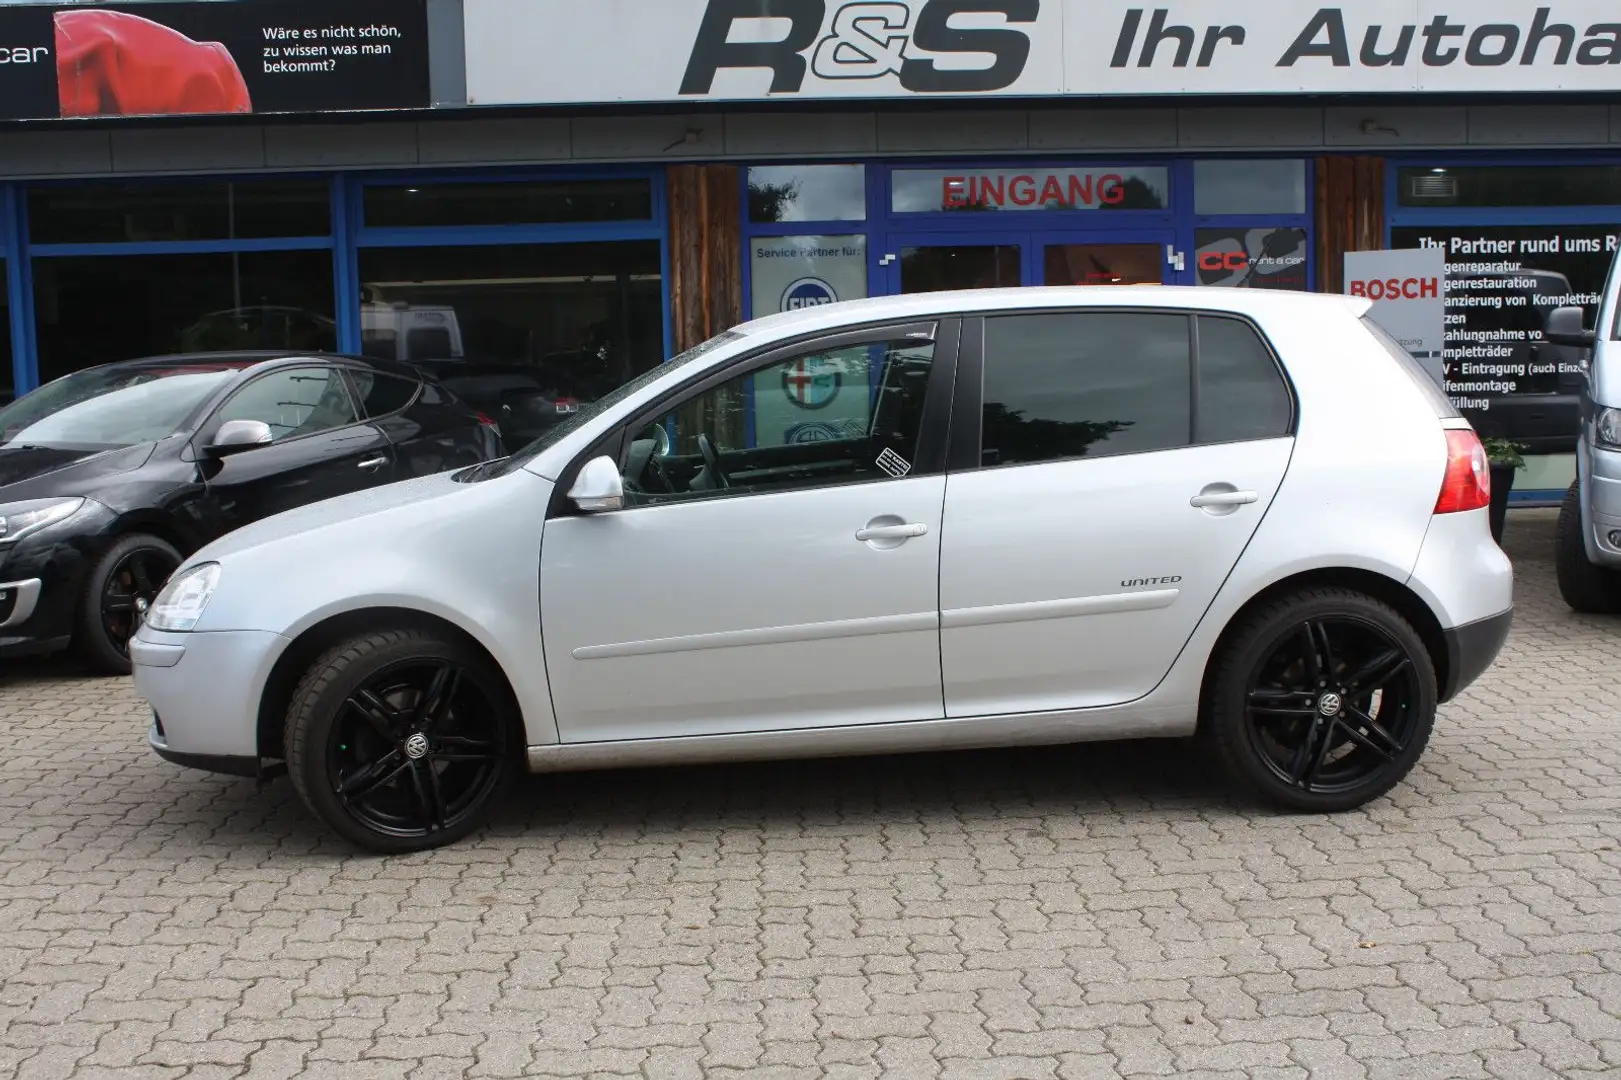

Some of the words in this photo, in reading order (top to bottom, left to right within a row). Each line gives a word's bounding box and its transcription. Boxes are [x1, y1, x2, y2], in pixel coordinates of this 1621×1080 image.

[263, 27, 299, 40] Wäre
[303, 28, 318, 39] es
[321, 25, 355, 38] nicht
[358, 24, 402, 38] schön,
[1110, 8, 1246, 68] Ihr
[263, 46, 280, 57] zu
[284, 44, 328, 56] wissen
[331, 45, 358, 55] was
[361, 44, 391, 54] man
[678, 0, 1040, 95] R&S
[263, 59, 336, 73] bekommt?
[942, 174, 1125, 208] EINGANG
[1450, 236, 1517, 254] Partner
[1520, 235, 1560, 253] rund
[1564, 238, 1601, 252] ums
[757, 248, 797, 258] Service
[842, 247, 861, 257] für:
[1351, 277, 1438, 300] BOSCH
[1505, 296, 1526, 306] von
[1462, 362, 1525, 377] Eintragung
[1528, 363, 1556, 376] (auch
[1120, 575, 1182, 587] UNITED
